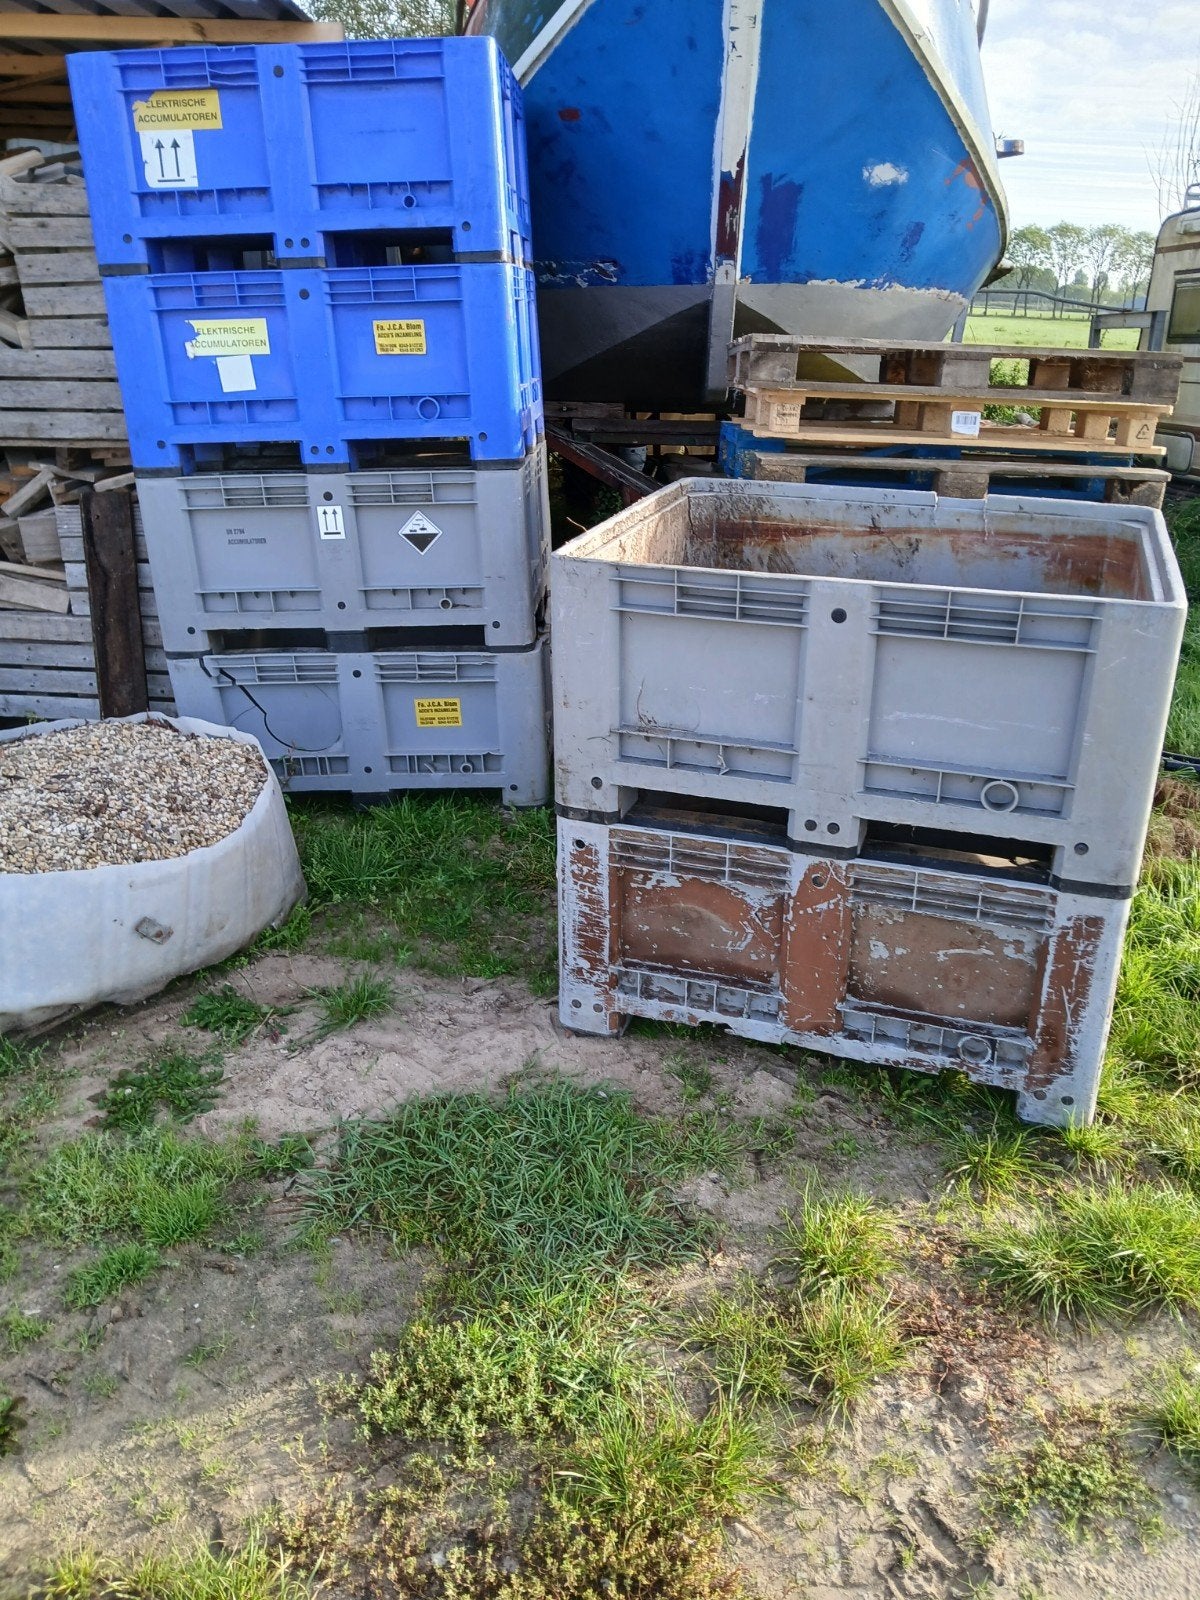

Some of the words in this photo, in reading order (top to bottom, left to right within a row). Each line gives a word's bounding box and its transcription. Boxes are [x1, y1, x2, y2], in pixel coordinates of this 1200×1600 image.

[138, 112, 218, 122] ACCUMULATOREN
[197, 327, 256, 335] ELEKTRISCHE
[387, 323, 404, 331] J.C.A.
